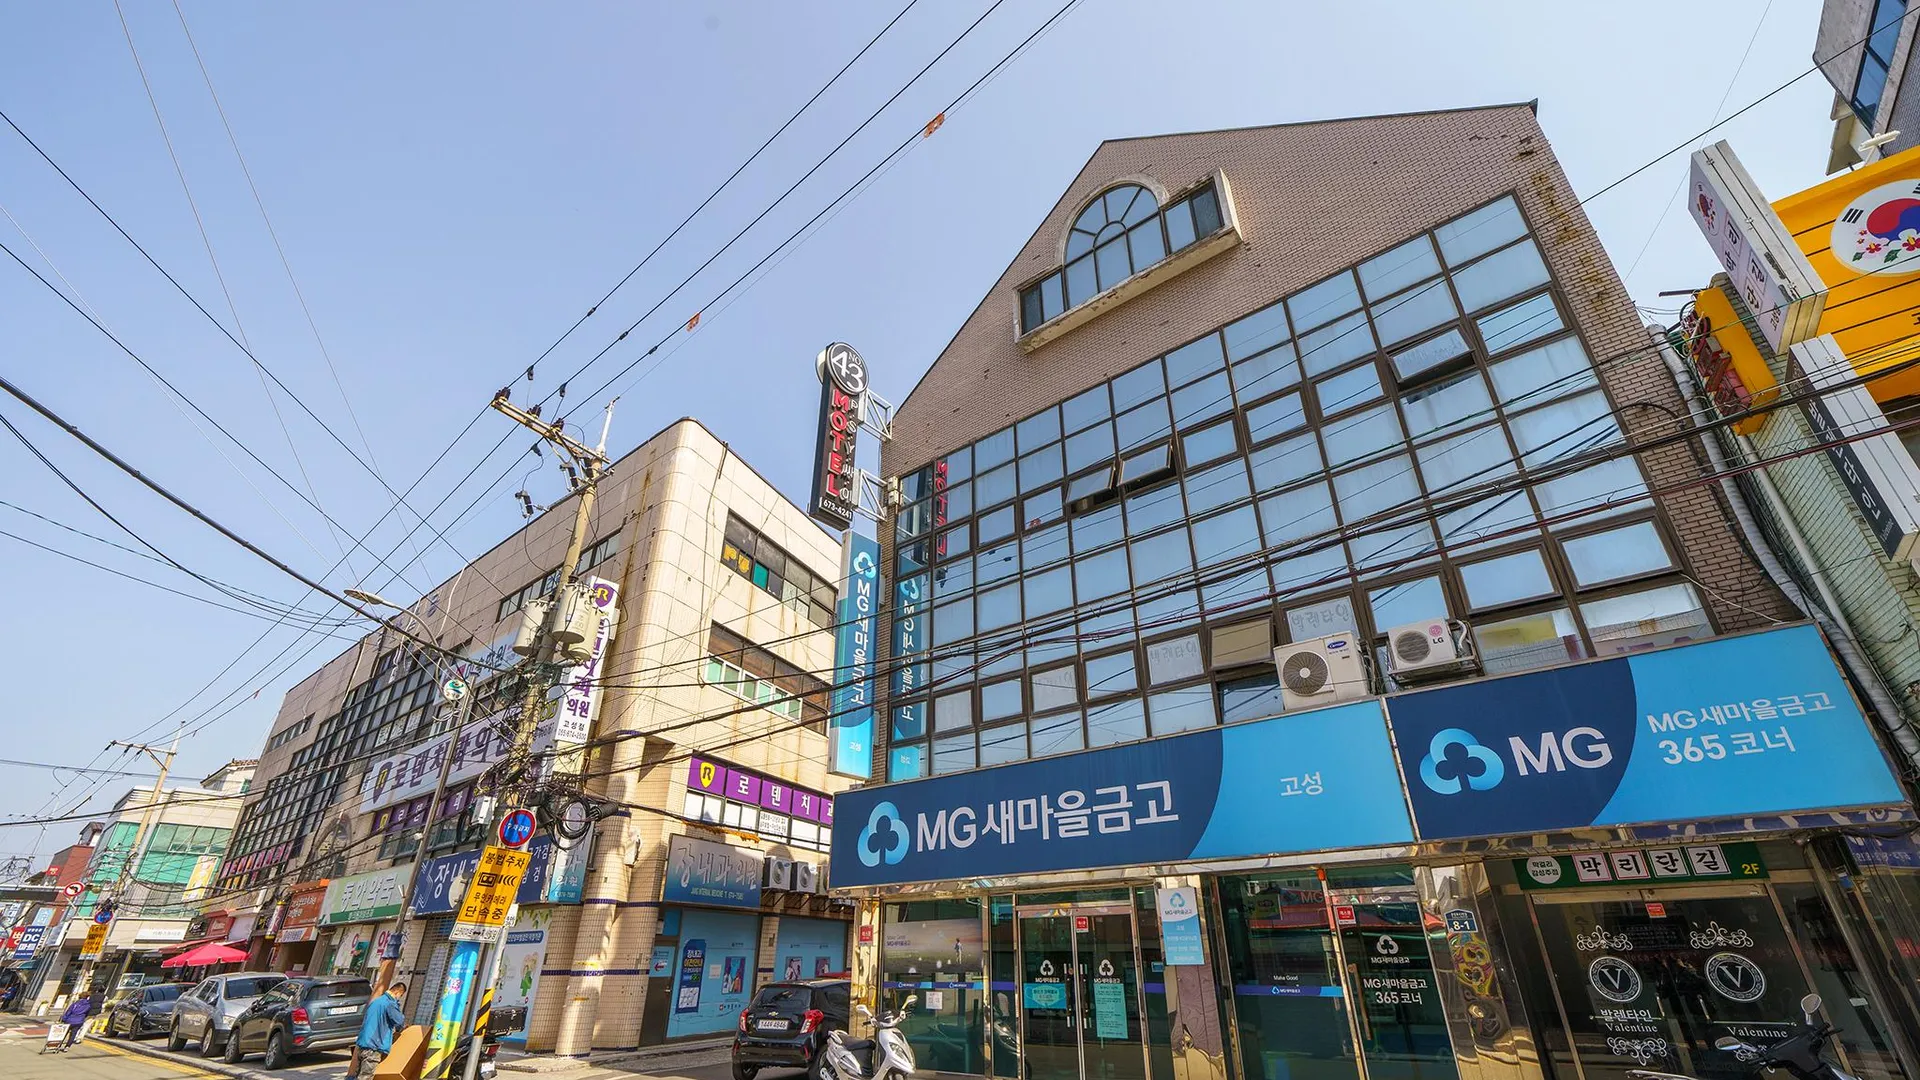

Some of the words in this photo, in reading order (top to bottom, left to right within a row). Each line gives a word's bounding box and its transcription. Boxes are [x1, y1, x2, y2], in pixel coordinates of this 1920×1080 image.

[832, 350, 864, 391] 43
[825, 387, 849, 498] MOTEL
[1432, 637, 1445, 645] LG
[566, 699, 591, 718] 의원
[1646, 691, 1837, 734] MG새마을금고
[1508, 726, 1613, 777] MG
[1658, 739, 1727, 766] 365
[1732, 726, 1796, 756] 코너
[1279, 771, 1325, 799] 고성
[916, 779, 1179, 854] MG새마을금고
[485, 851, 527, 868] 불법주차
[1532, 860, 1553, 868] 막걸리
[1579, 849, 1721, 877] 막리단길
[1741, 862, 1760, 875] 2F
[473, 891, 508, 905] 무인카메라
[465, 905, 503, 920] 단속중
[1453, 919, 1471, 931] 8-1
[22, 933, 40, 942] DC
[1363, 978, 1428, 990] MG새마을금고
[1601, 968, 1622, 990] V
[1719, 965, 1743, 988] V
[1376, 992, 1399, 1004] 365
[1400, 991, 1423, 1005] 코너
[1600, 1008, 1653, 1023] 발렌타인
[1606, 1022, 1658, 1034] Valentine
[1727, 1025, 1788, 1039] Valentine
